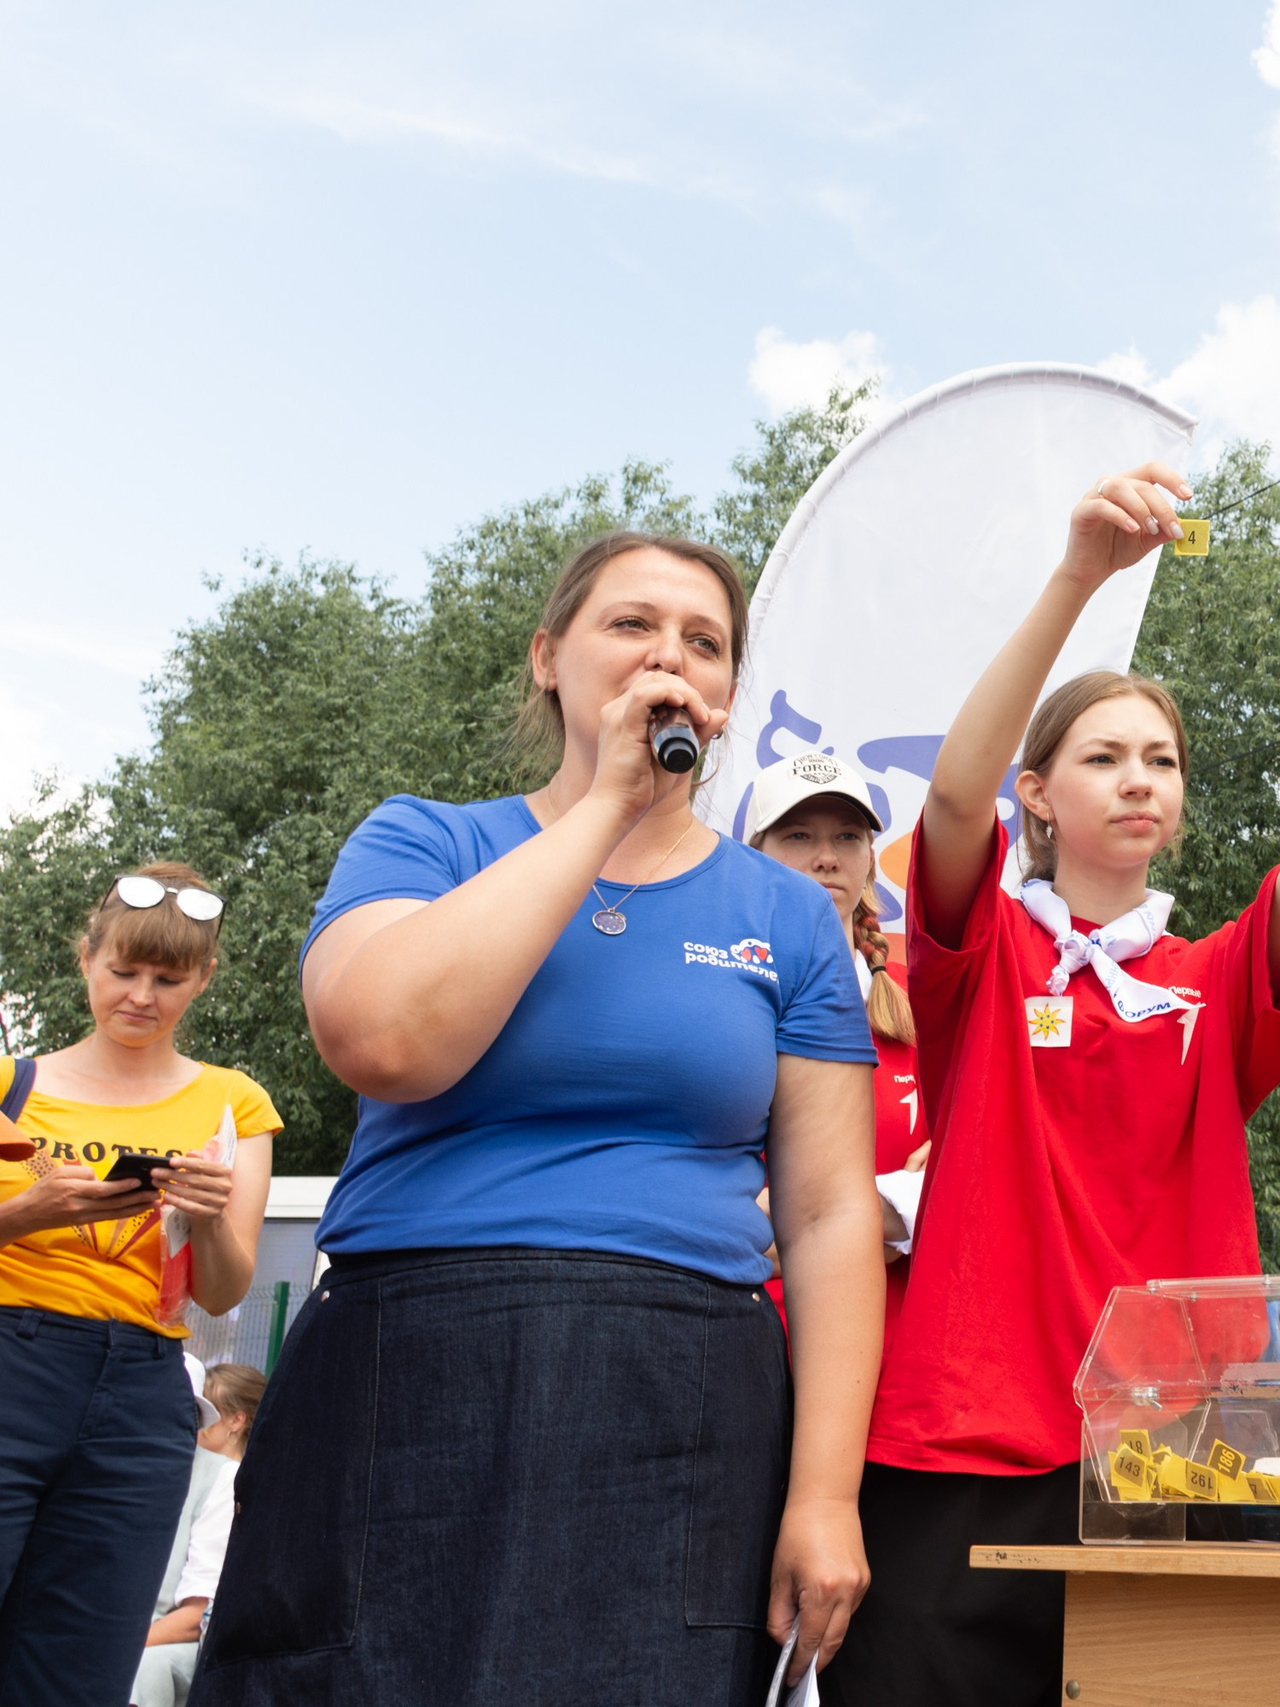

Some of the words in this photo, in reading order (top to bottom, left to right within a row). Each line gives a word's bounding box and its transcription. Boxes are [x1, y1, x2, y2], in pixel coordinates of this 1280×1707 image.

[1187, 530, 1196, 545] 4
[792, 763, 842, 776] FORCE
[683, 942, 729, 959] союз
[685, 952, 779, 982] родителе
[1119, 1456, 1141, 1477] 143
[1218, 1448, 1236, 1474] 186
[1190, 1470, 1214, 1491] 192
